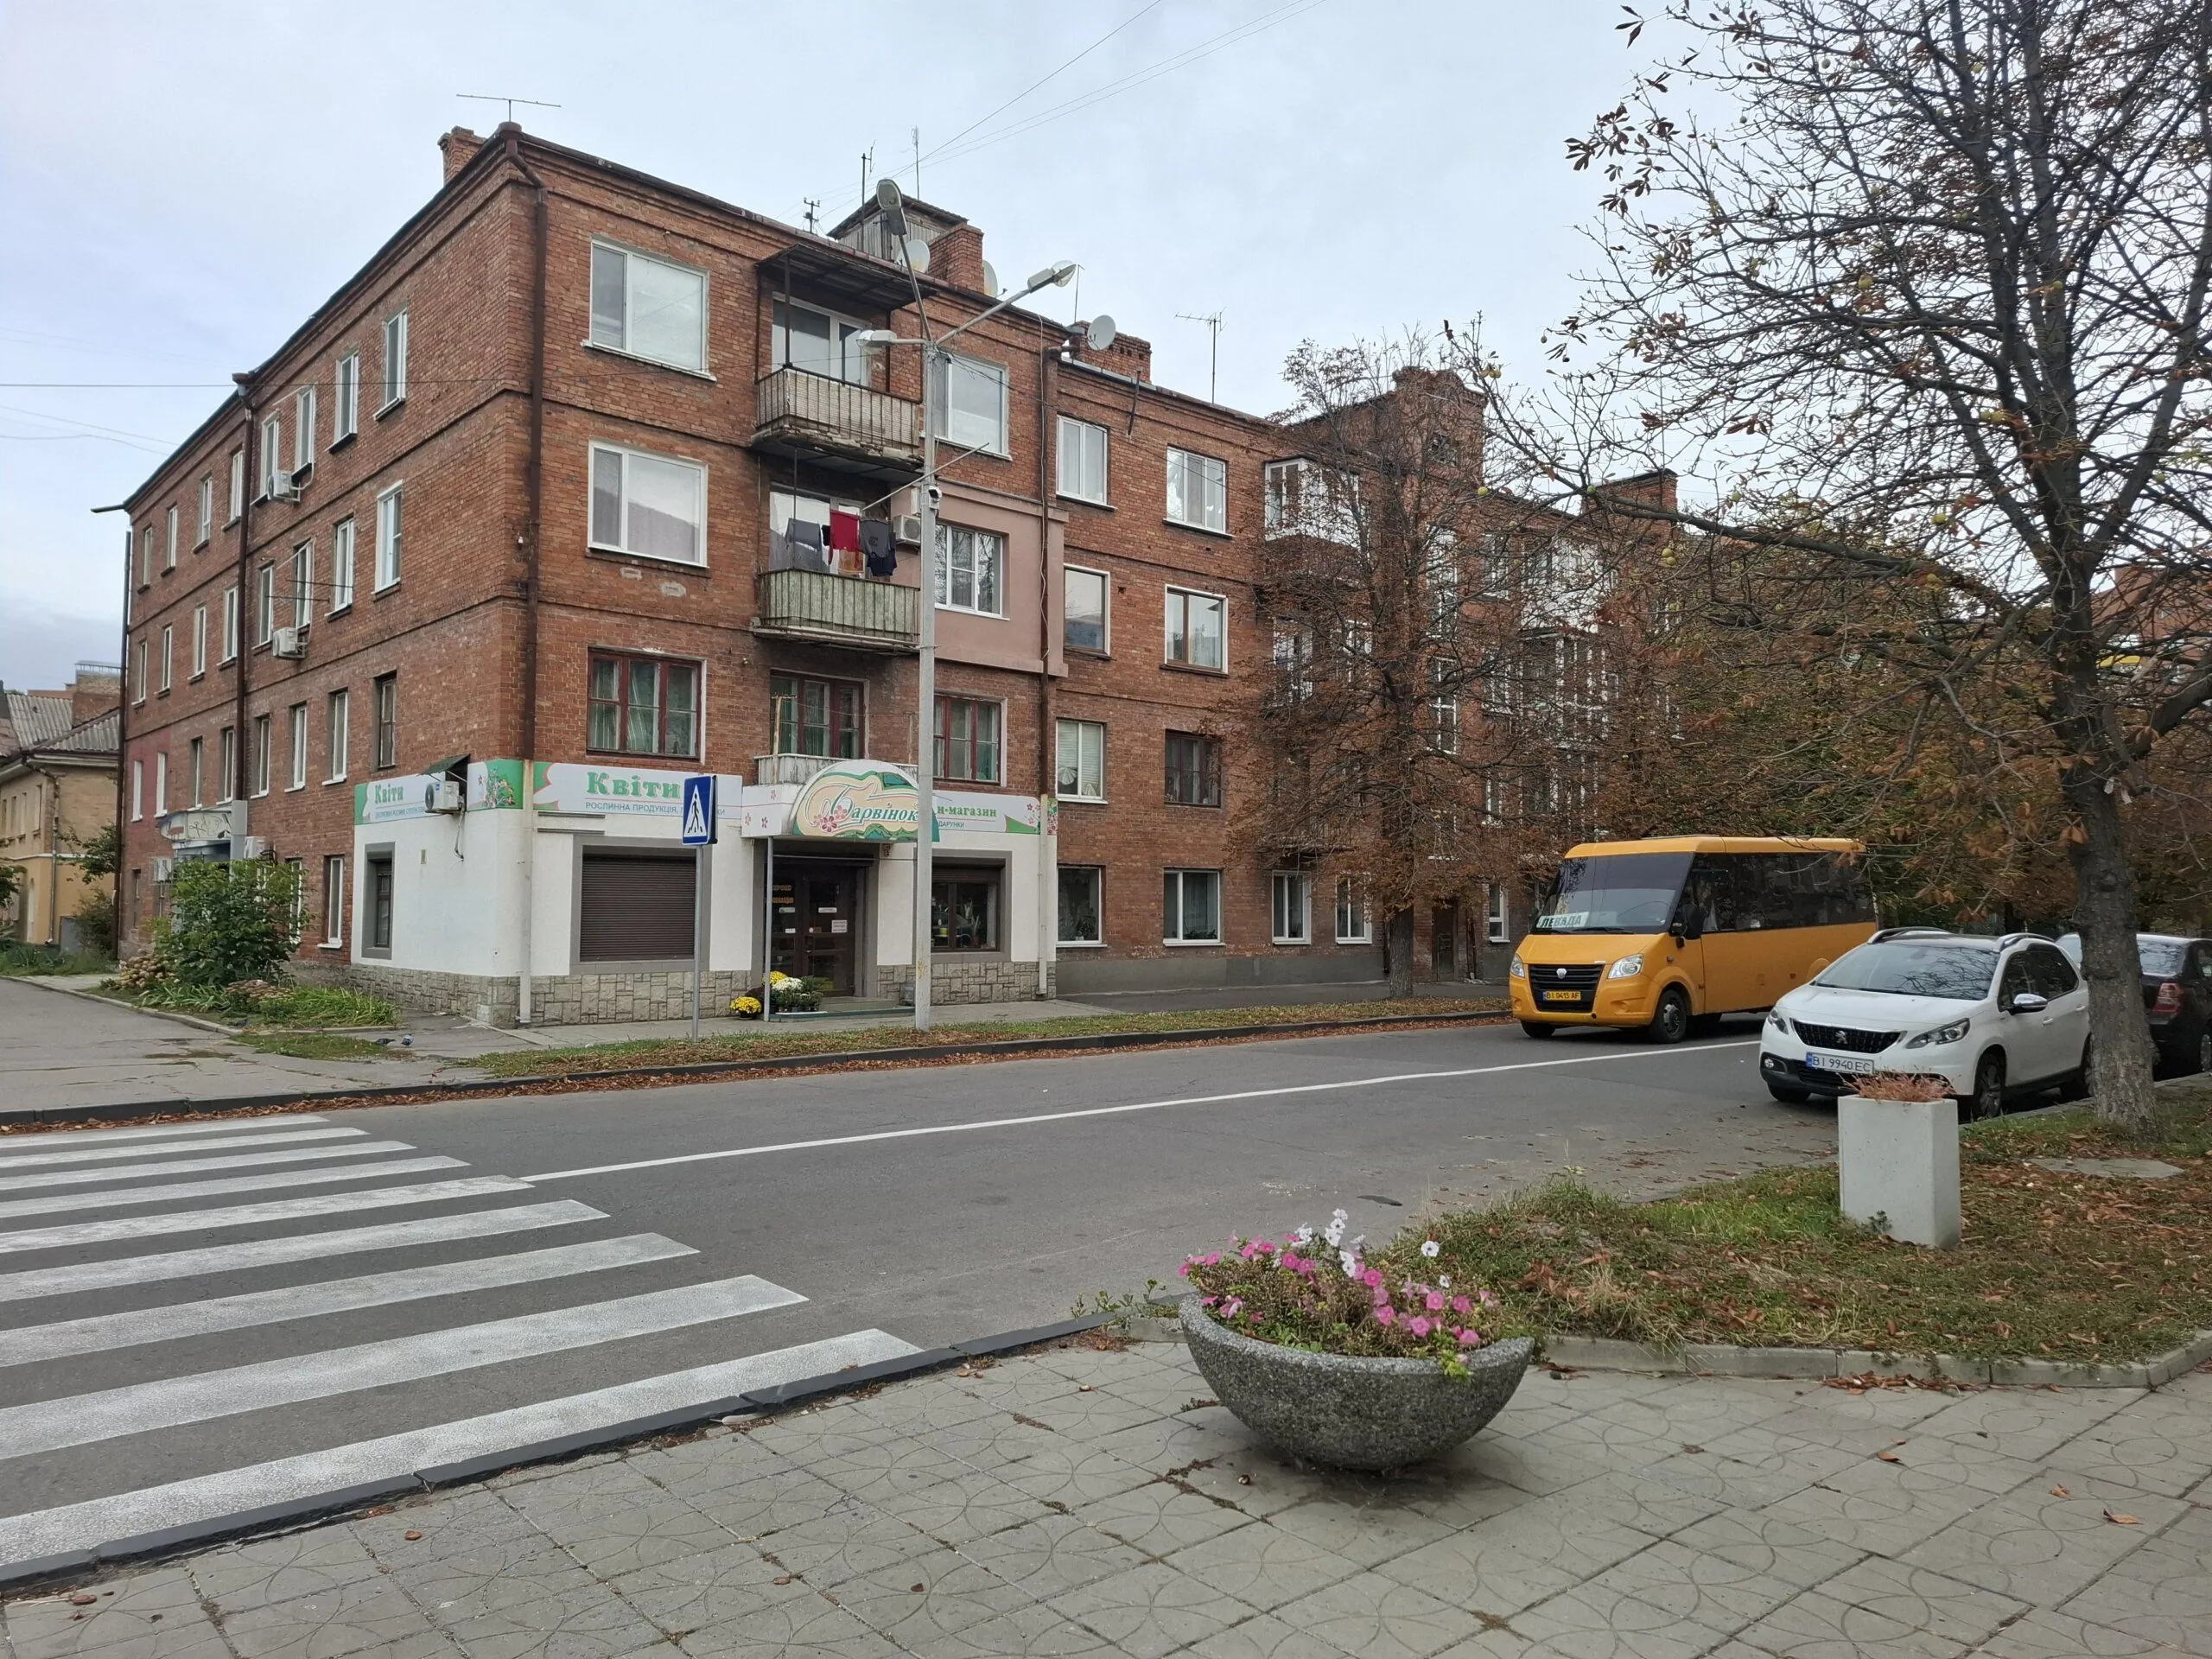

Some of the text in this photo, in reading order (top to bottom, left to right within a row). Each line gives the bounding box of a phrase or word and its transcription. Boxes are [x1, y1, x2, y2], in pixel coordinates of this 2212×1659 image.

[586, 772, 681, 798] Квіти
[374, 784, 404, 804] Квіти
[586, 802, 630, 811] РОСЛИННА
[1540, 915, 1582, 928] ЛЕВАДА
[1813, 1056, 1872, 1072] BI 9940 EC
